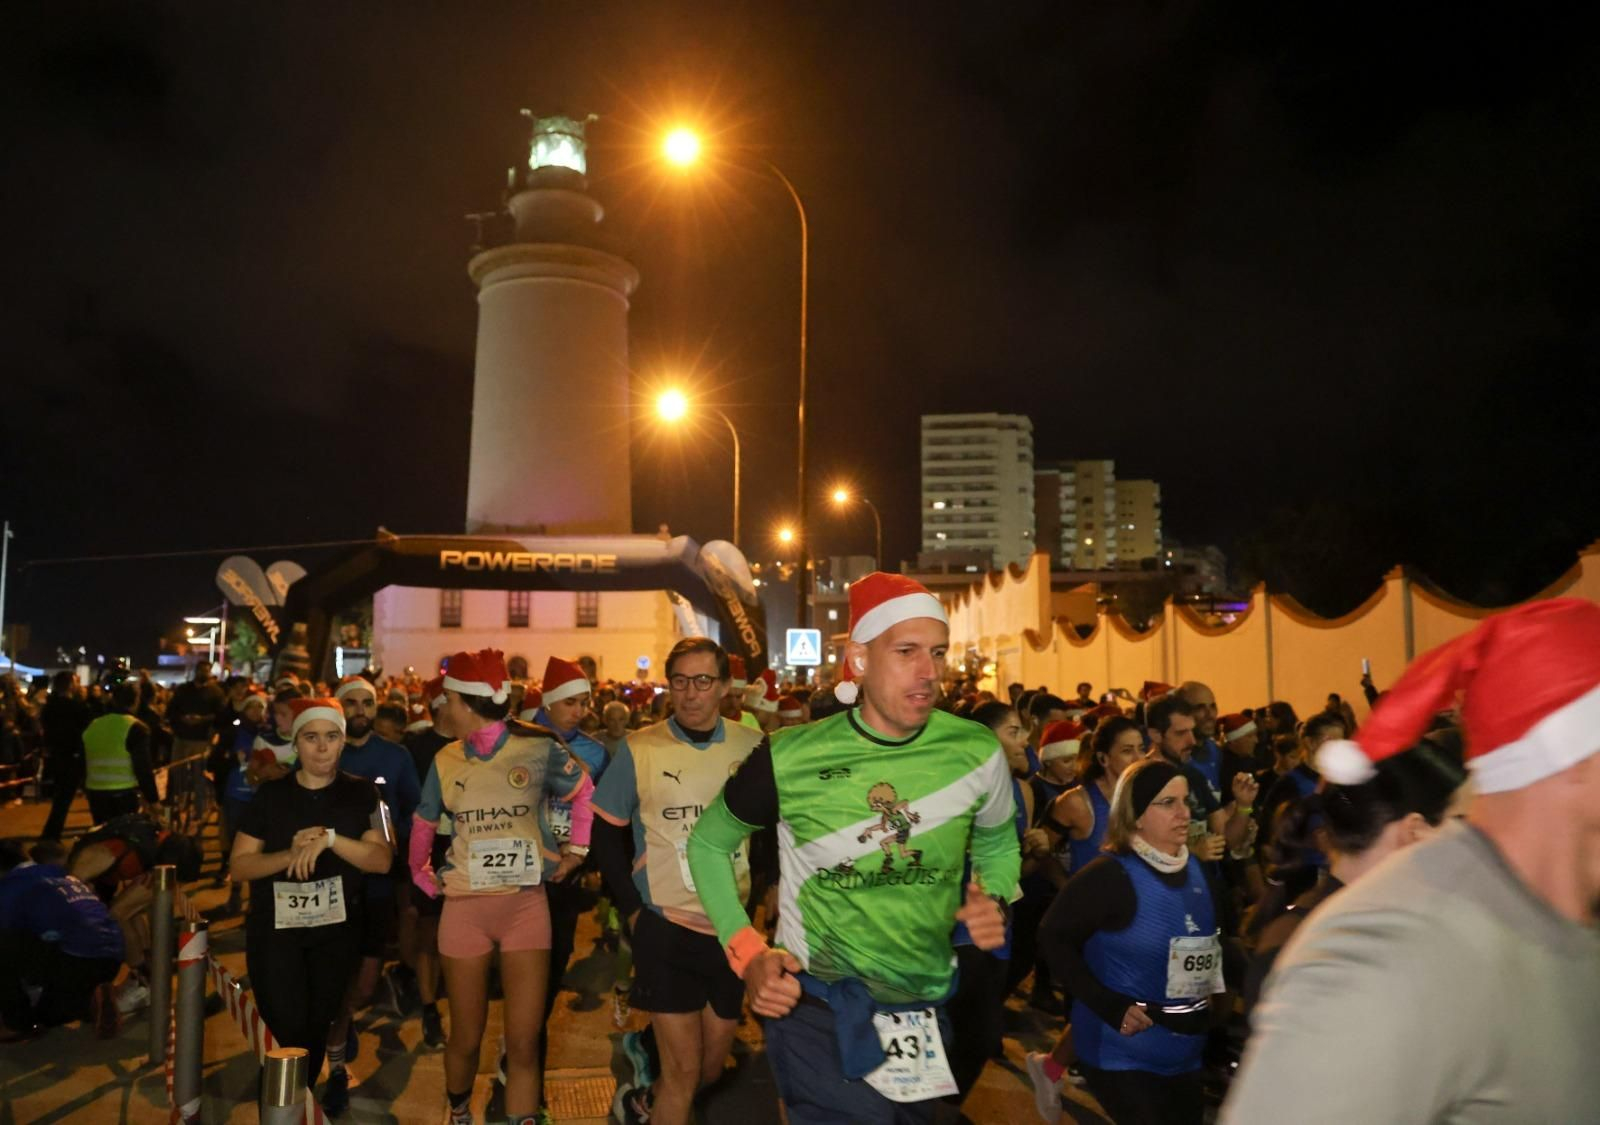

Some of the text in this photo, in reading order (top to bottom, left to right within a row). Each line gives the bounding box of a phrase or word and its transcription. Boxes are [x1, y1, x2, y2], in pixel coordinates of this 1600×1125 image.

[440, 550, 618, 574] POWERADE
[455, 805, 531, 824] ETIHAD
[549, 825, 571, 837] 52
[482, 853, 518, 867] 227
[288, 894, 320, 908] 371
[1183, 954, 1213, 972] 698
[886, 1035, 919, 1059] 43
